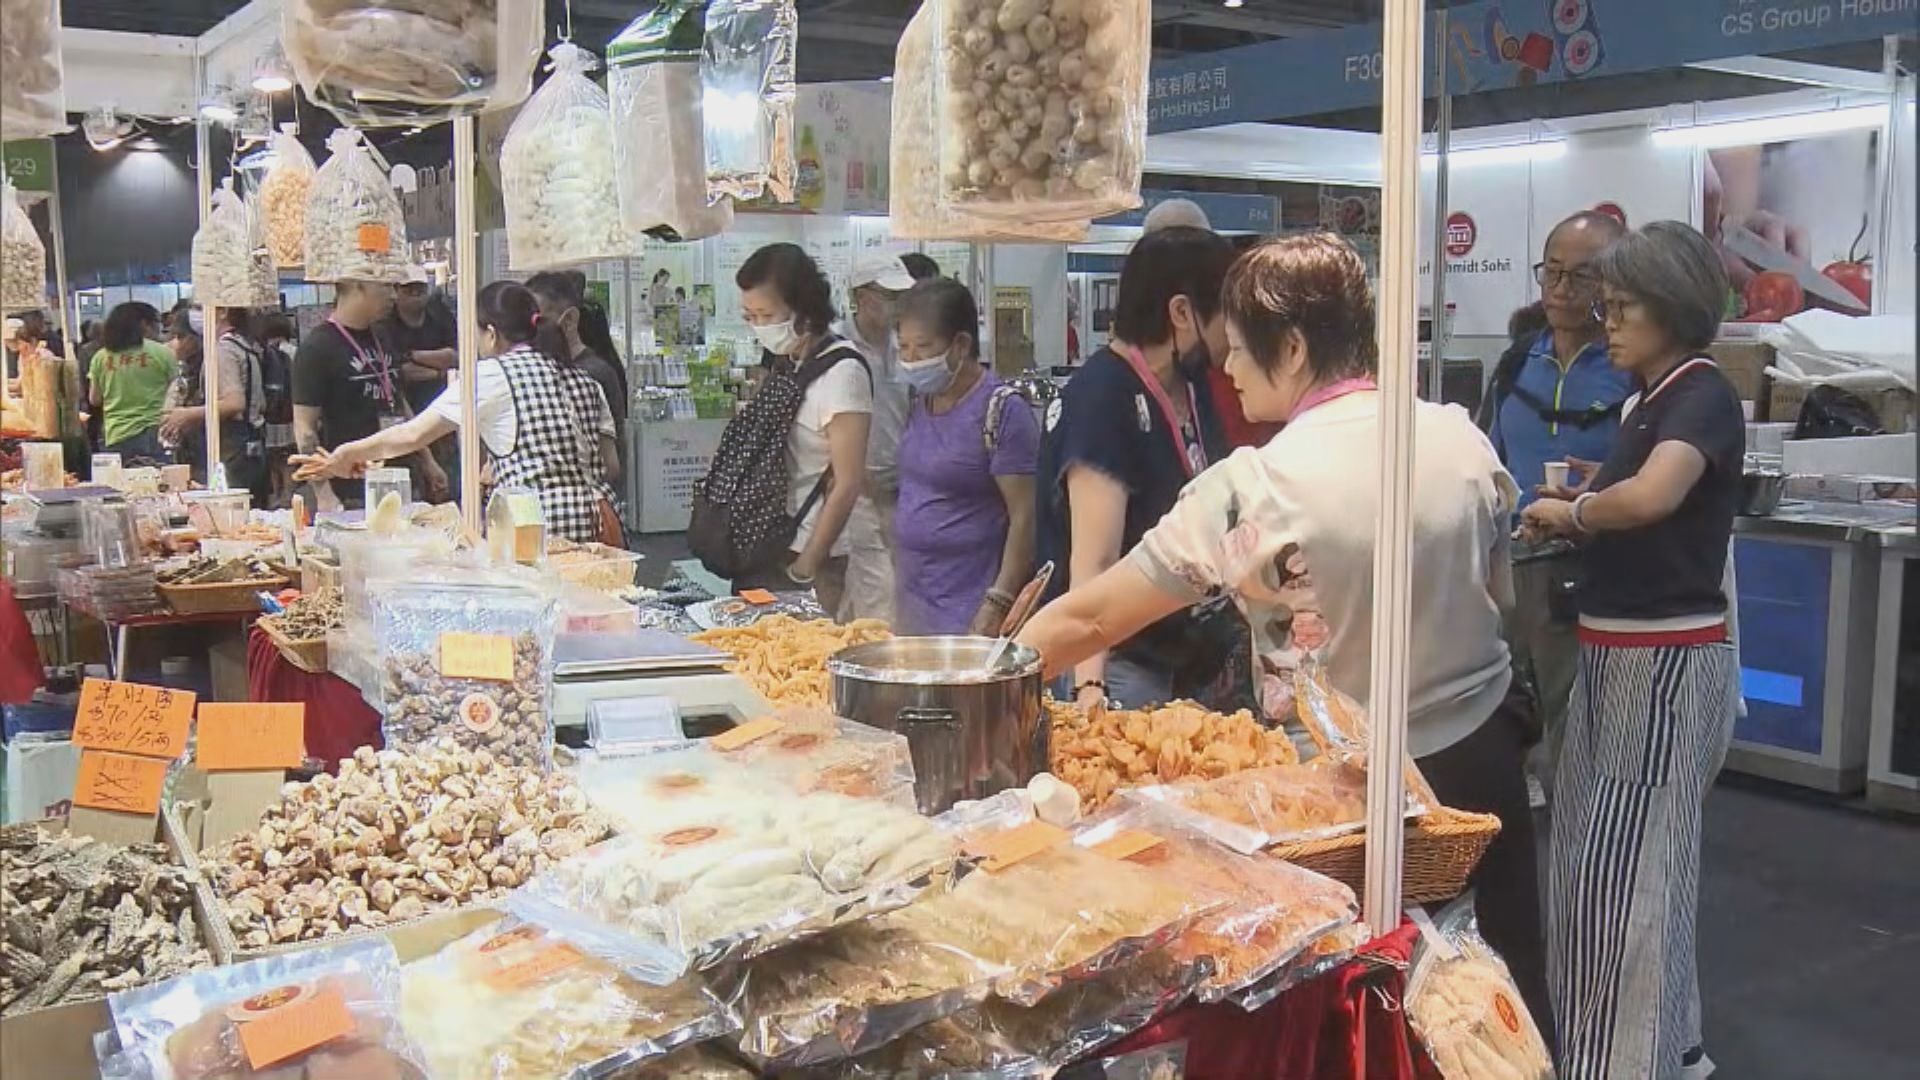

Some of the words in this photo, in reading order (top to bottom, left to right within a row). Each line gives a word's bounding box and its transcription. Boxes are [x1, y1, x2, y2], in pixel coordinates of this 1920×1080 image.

[1721, 12, 1754, 36] CS
[1761, 5, 1831, 30] Group
[1160, 100, 1210, 118] Holdings
[1213, 93, 1231, 112] Ltd
[9, 157, 36, 176] 29
[1445, 258, 1480, 274] hmidt
